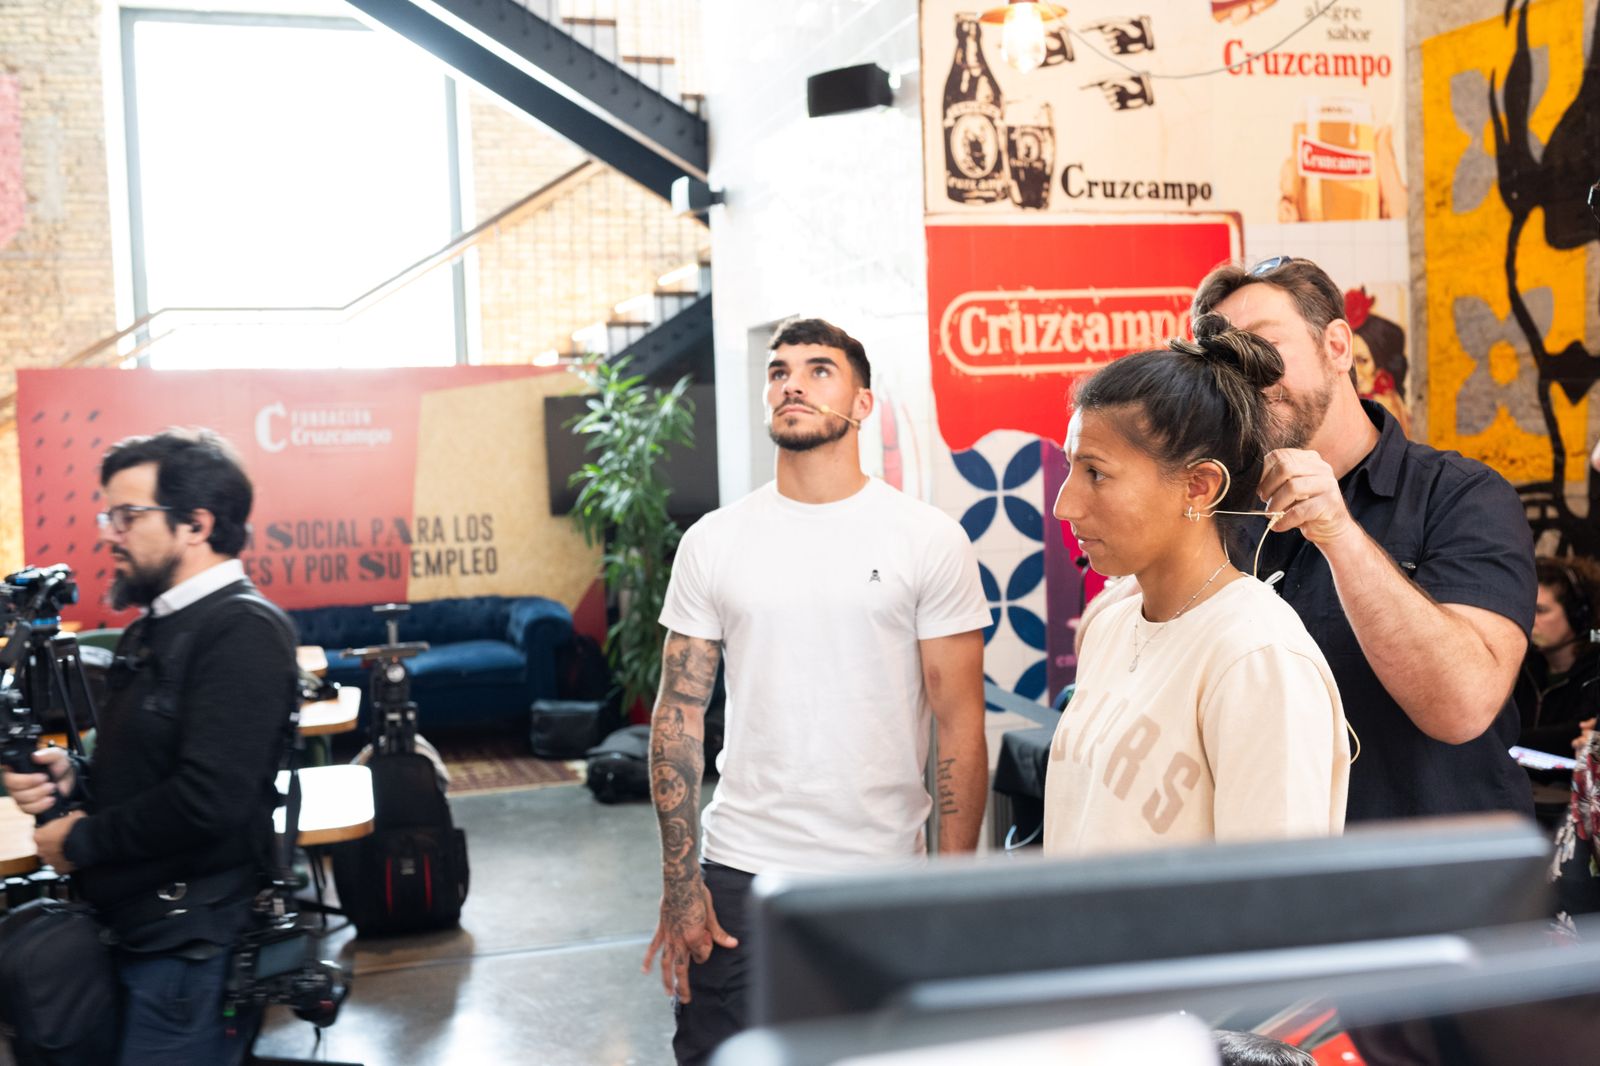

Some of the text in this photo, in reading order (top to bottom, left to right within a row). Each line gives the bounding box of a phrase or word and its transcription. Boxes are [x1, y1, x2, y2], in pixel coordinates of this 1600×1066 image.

[1223, 38, 1392, 87] Cruzcampo
[1061, 163, 1212, 206] Cruzcampo
[290, 427, 393, 448] Cruzcampo
[265, 519, 363, 552] SOCIAL
[370, 515, 446, 547] PARA
[453, 513, 495, 545] LOS
[280, 554, 297, 586] Y
[304, 552, 350, 585] POR
[357, 551, 402, 583] SU
[409, 545, 499, 579] EMPLEO
